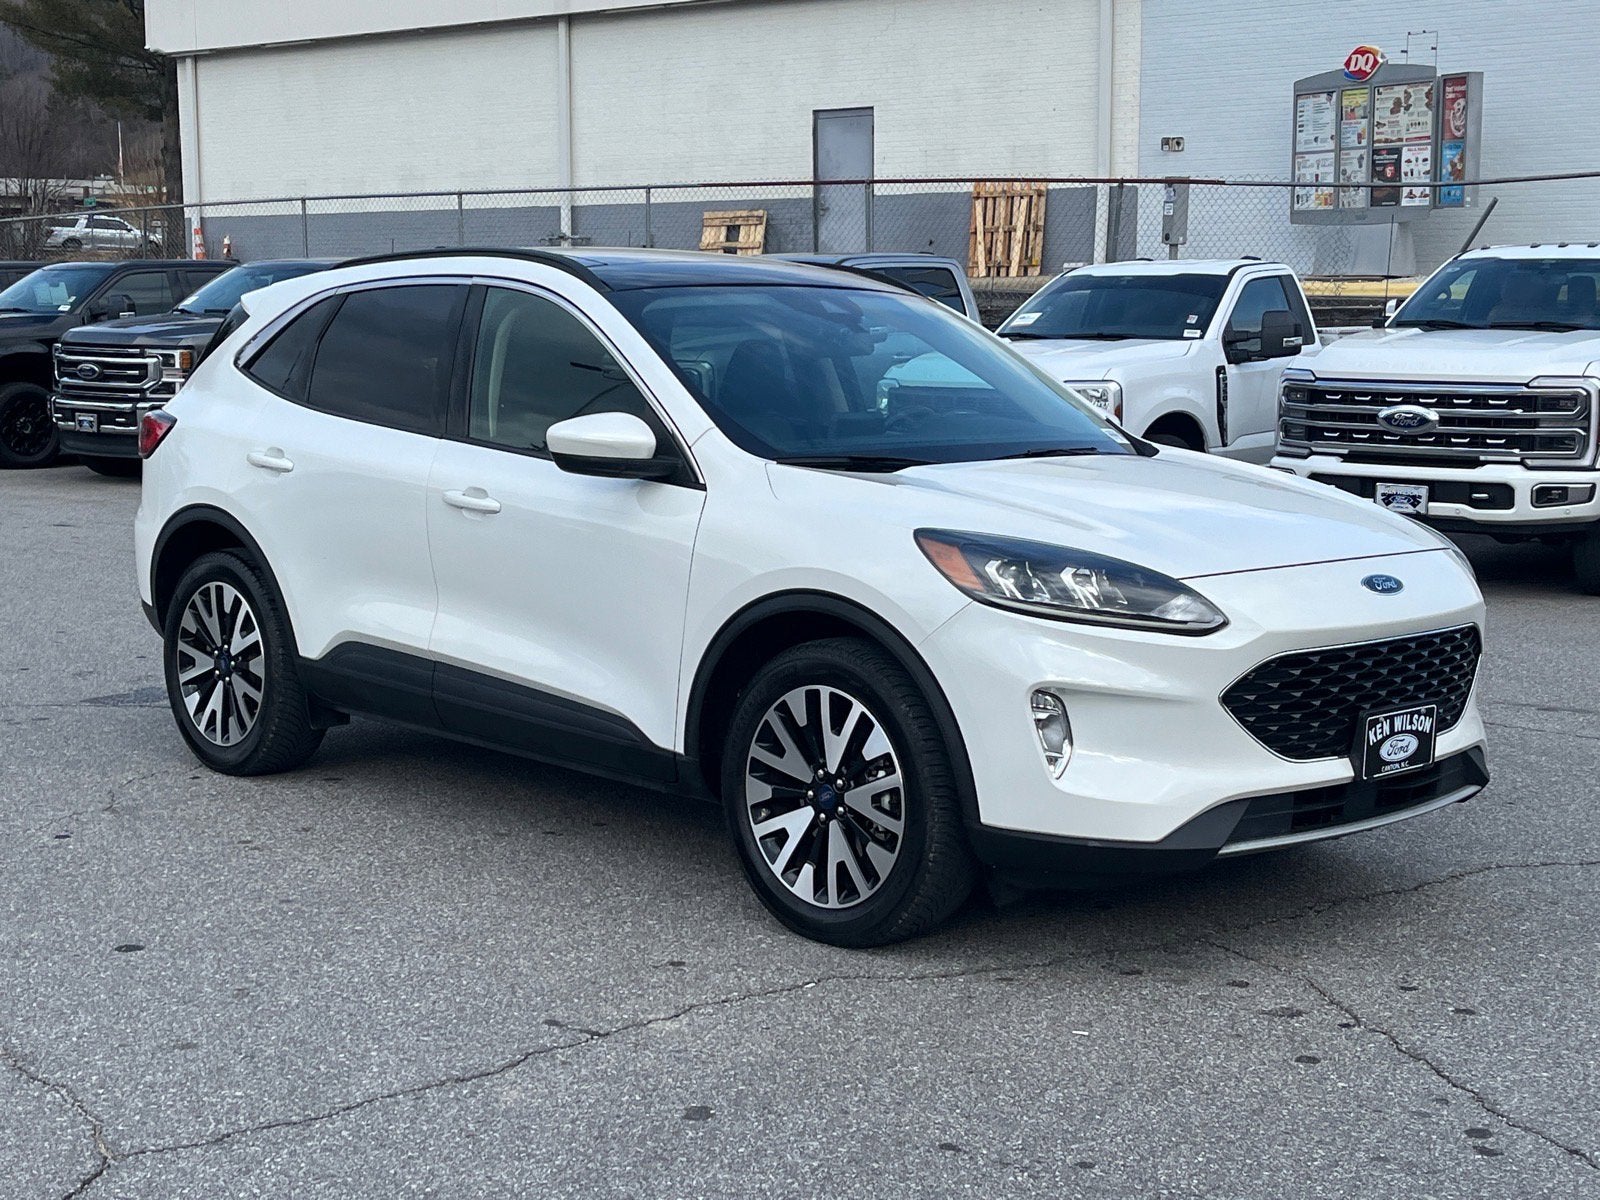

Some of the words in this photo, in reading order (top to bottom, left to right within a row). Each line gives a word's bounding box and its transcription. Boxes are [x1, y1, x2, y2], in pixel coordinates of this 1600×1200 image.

[1349, 54, 1374, 72] DQ
[1391, 412, 1420, 425] Ford
[1373, 577, 1397, 590] Ford
[1369, 719, 1390, 746] KEN
[1394, 714, 1433, 733] WILSON
[1387, 738, 1411, 756] Ford
